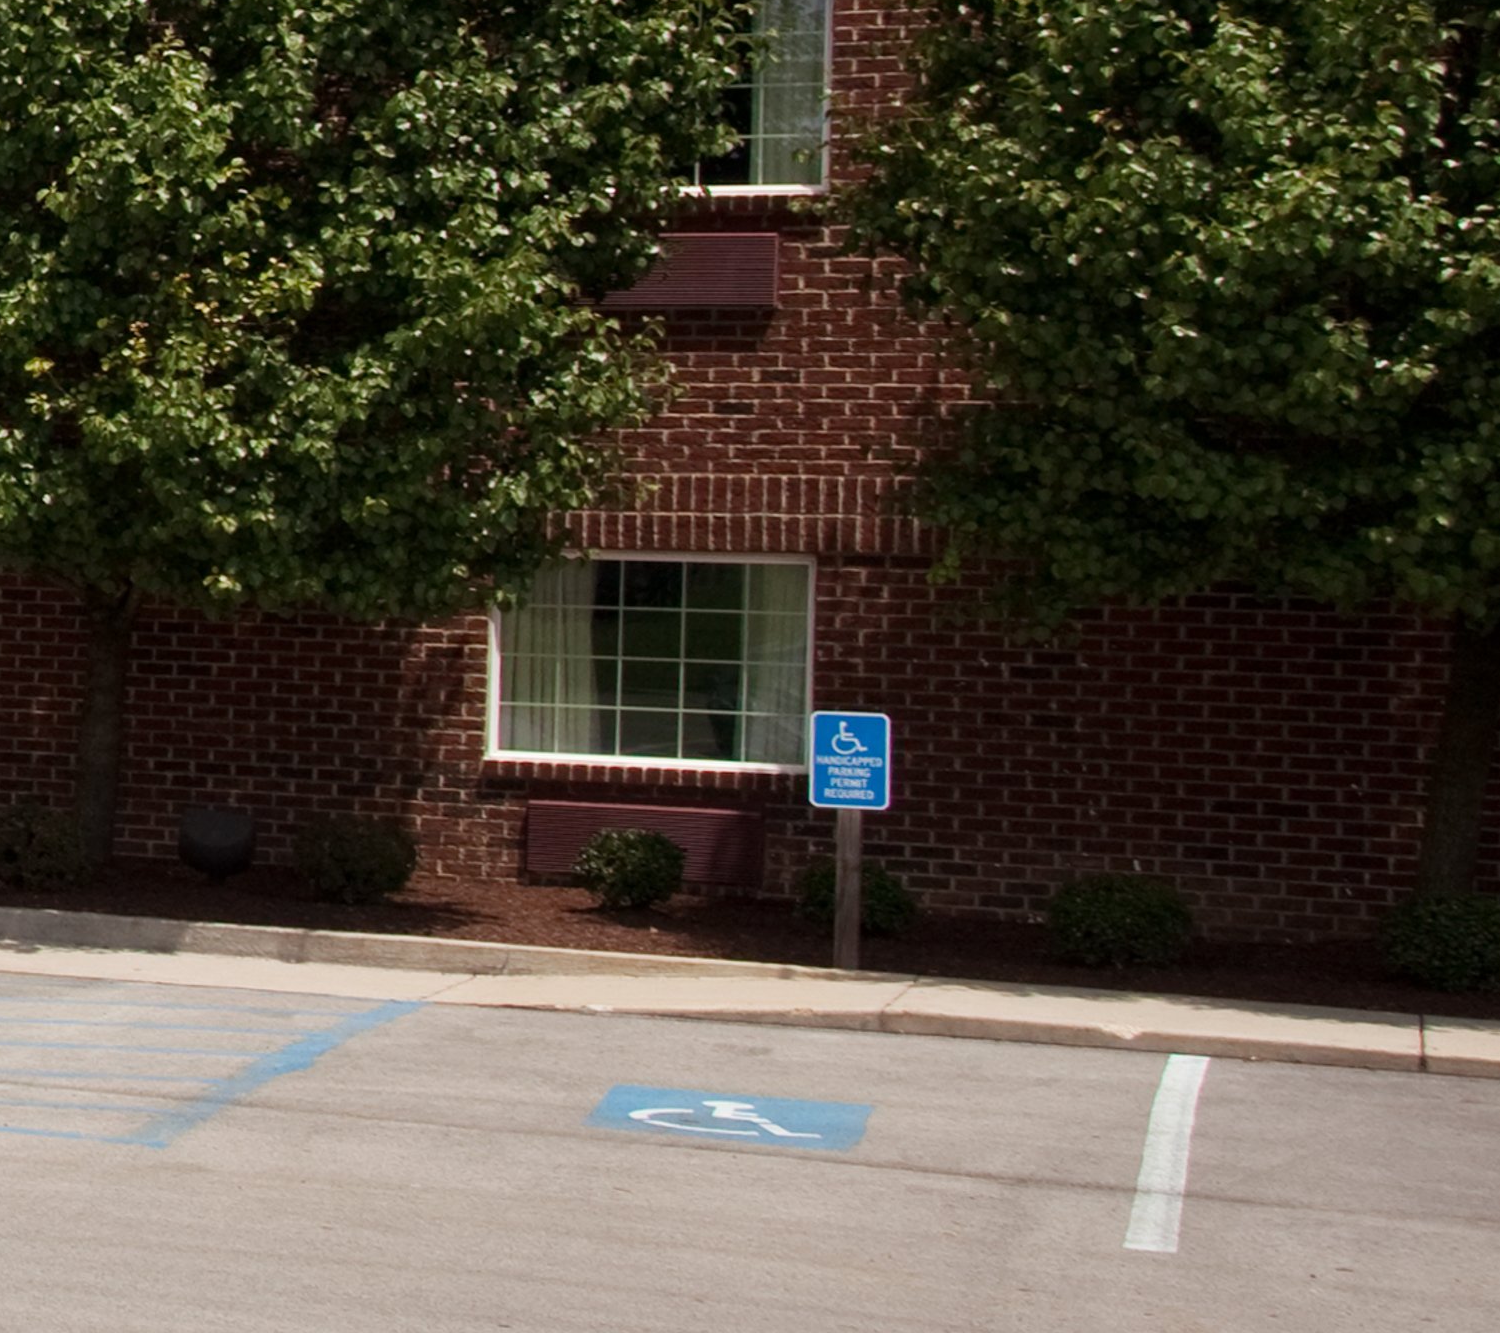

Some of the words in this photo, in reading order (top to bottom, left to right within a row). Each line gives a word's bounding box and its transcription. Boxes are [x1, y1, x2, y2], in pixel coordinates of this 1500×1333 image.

[816, 756, 883, 767] HANDICAPPED
[828, 767, 871, 778] PARKING
[830, 778, 868, 788] PERMIT
[823, 788, 875, 800] REQUIRED
